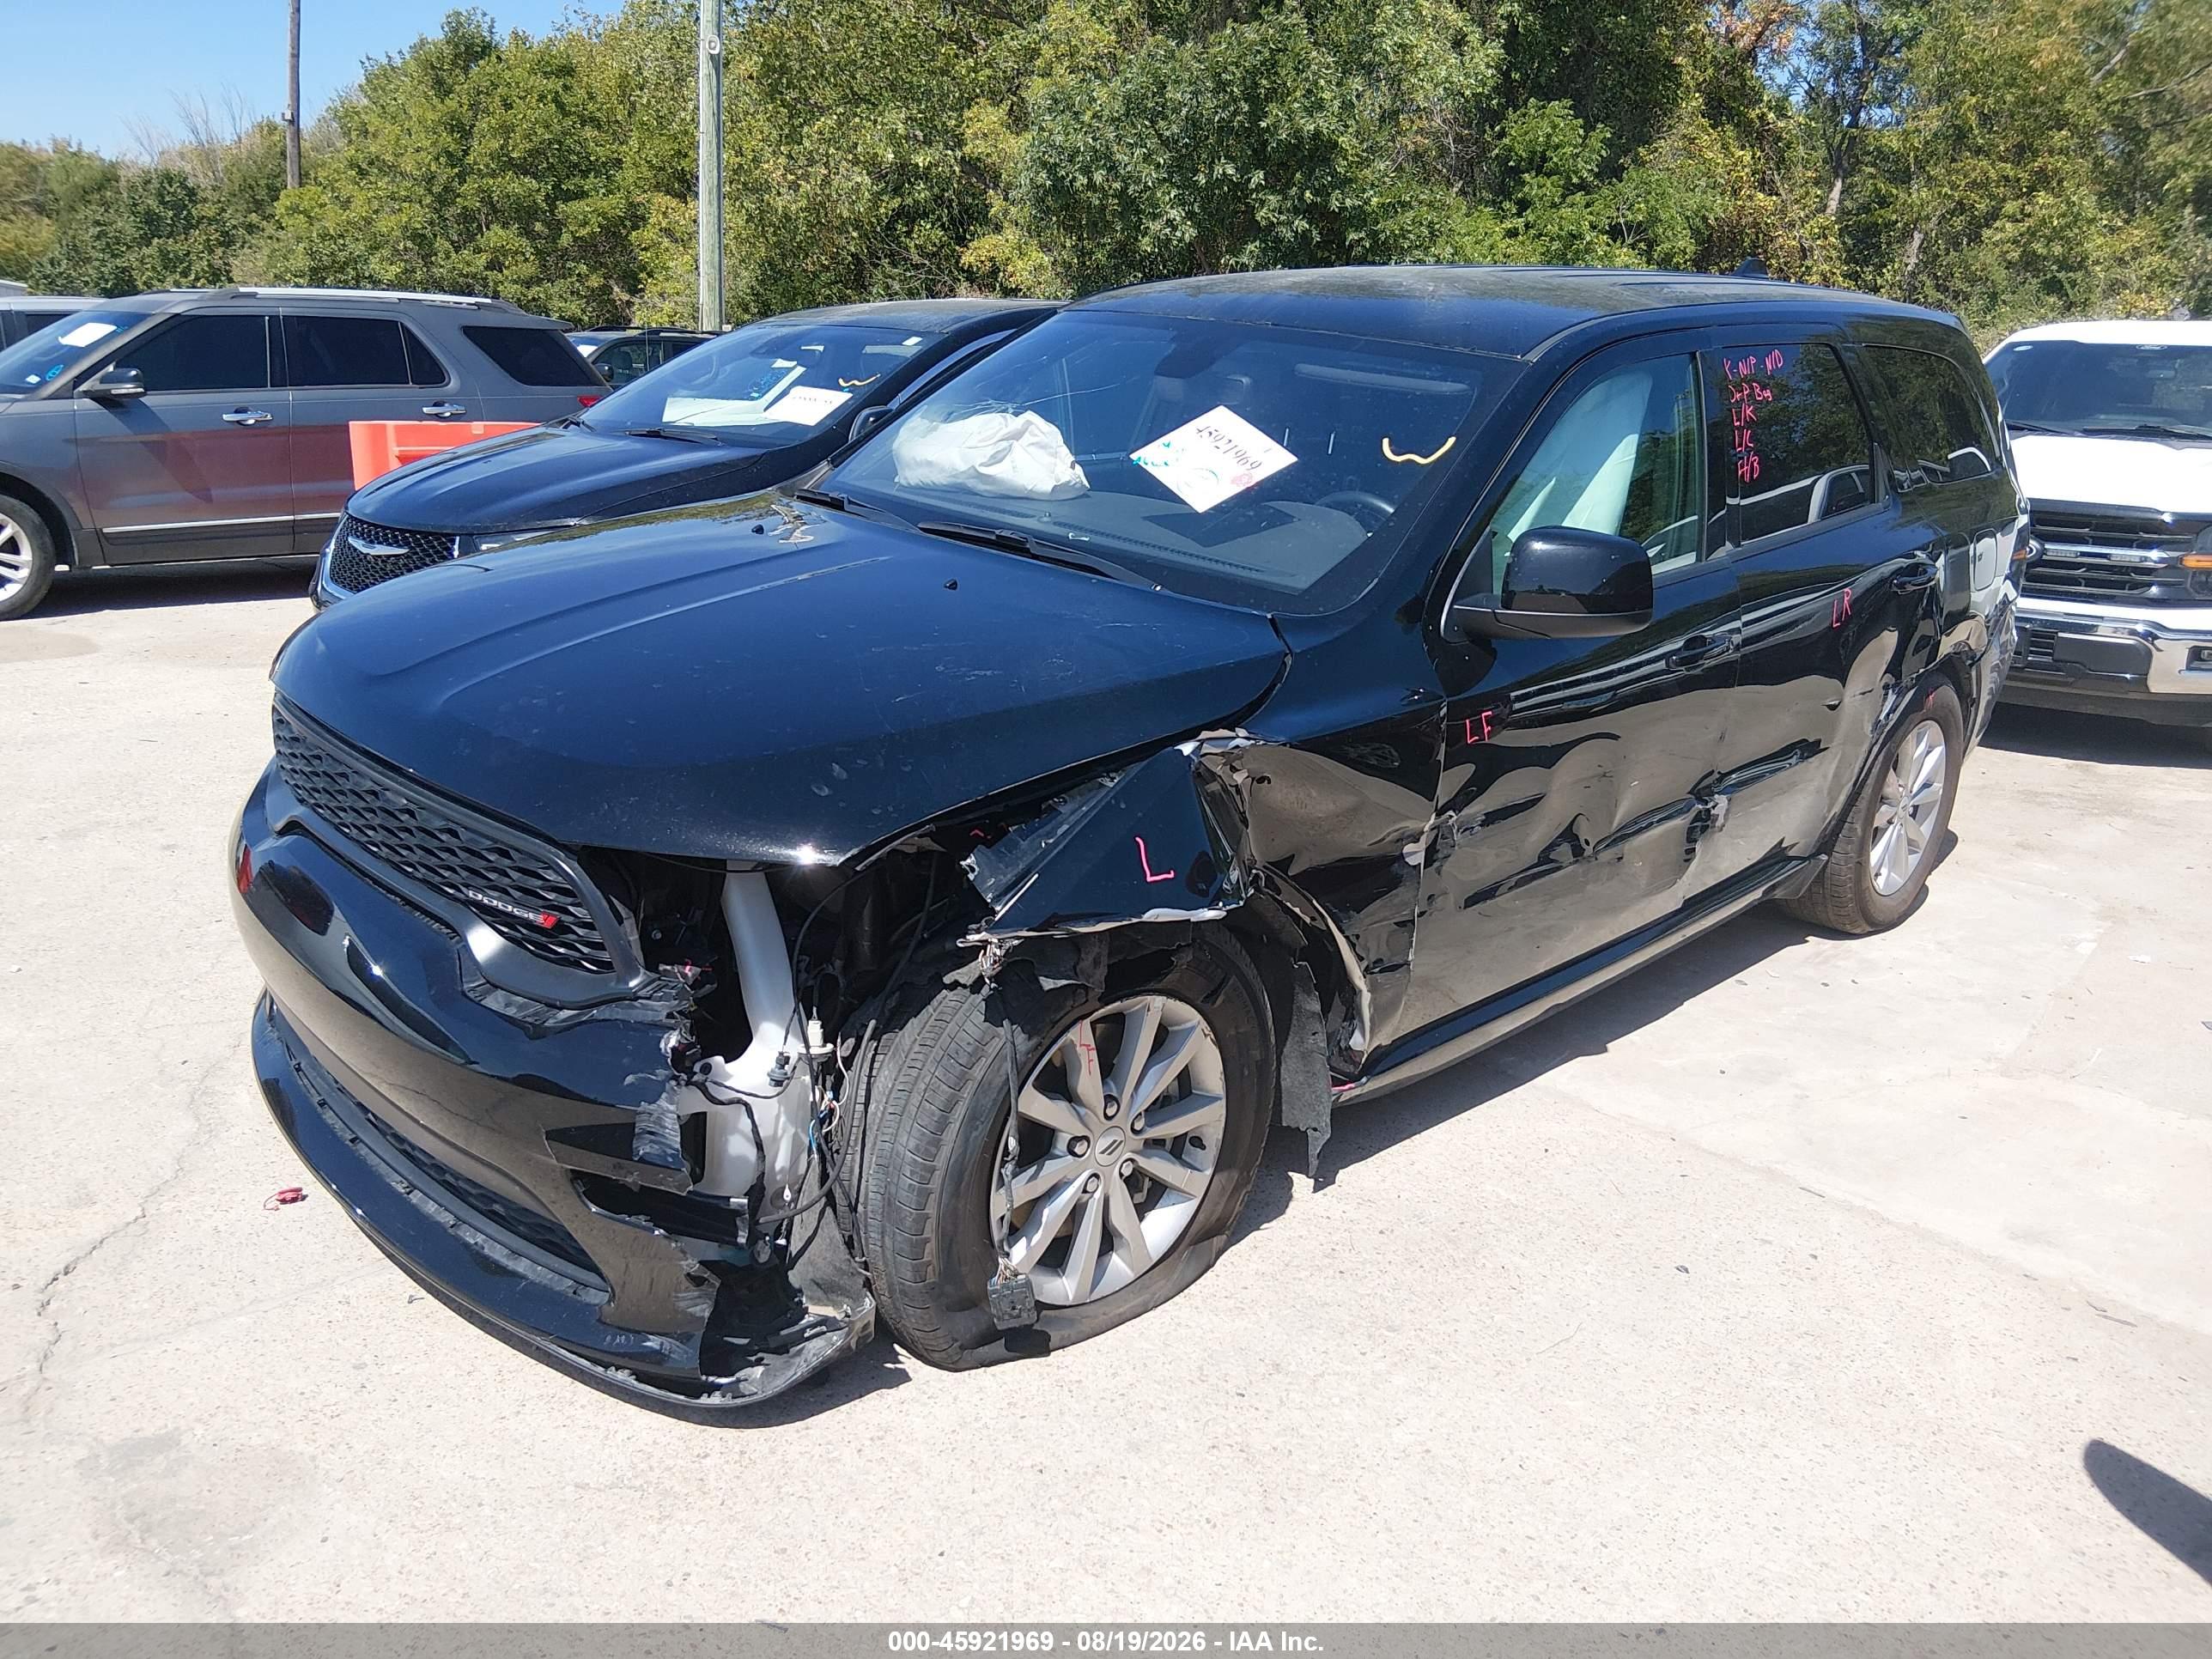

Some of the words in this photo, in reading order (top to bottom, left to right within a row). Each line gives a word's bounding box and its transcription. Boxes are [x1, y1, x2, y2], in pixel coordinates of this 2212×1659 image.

[1832, 587, 1852, 628] LR
[1466, 711, 1492, 744] LF
[1134, 836, 1175, 882] L
[468, 890, 545, 924] DODGE
